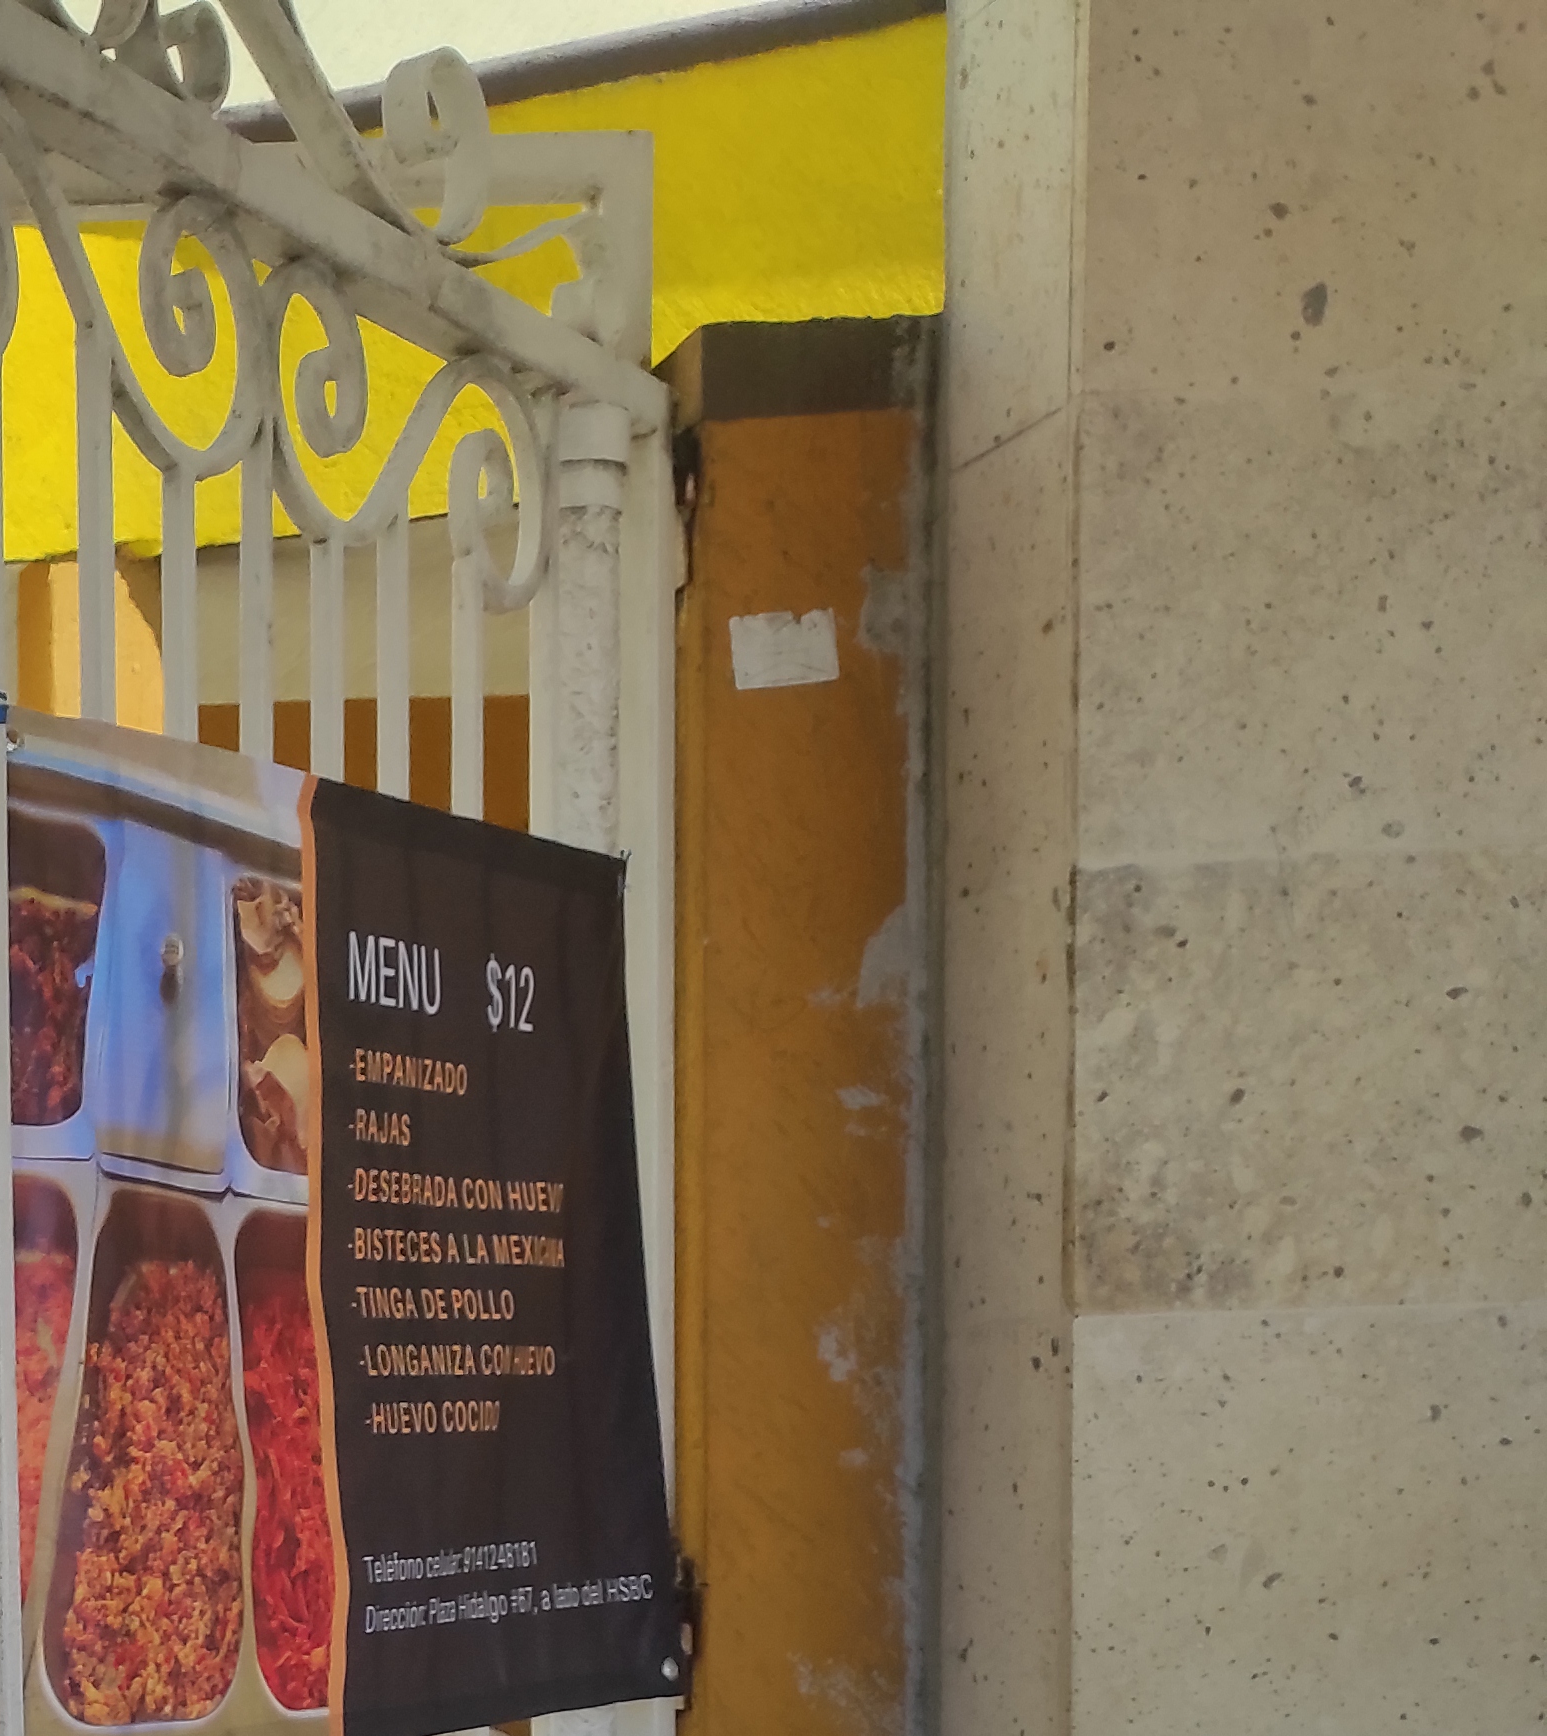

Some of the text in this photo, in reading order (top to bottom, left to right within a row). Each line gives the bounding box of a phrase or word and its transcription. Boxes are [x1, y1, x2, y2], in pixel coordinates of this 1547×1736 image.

[348, 930, 535, 1033] MENU $12
[462, 1177, 504, 1210] CON
[447, 1232, 460, 1264] A
[463, 1233, 490, 1265] LA
[420, 1288, 449, 1320] DE
[451, 1288, 515, 1321] POLLO
[540, 1590, 552, 1611] a
[606, 1574, 654, 1603] HSBC
